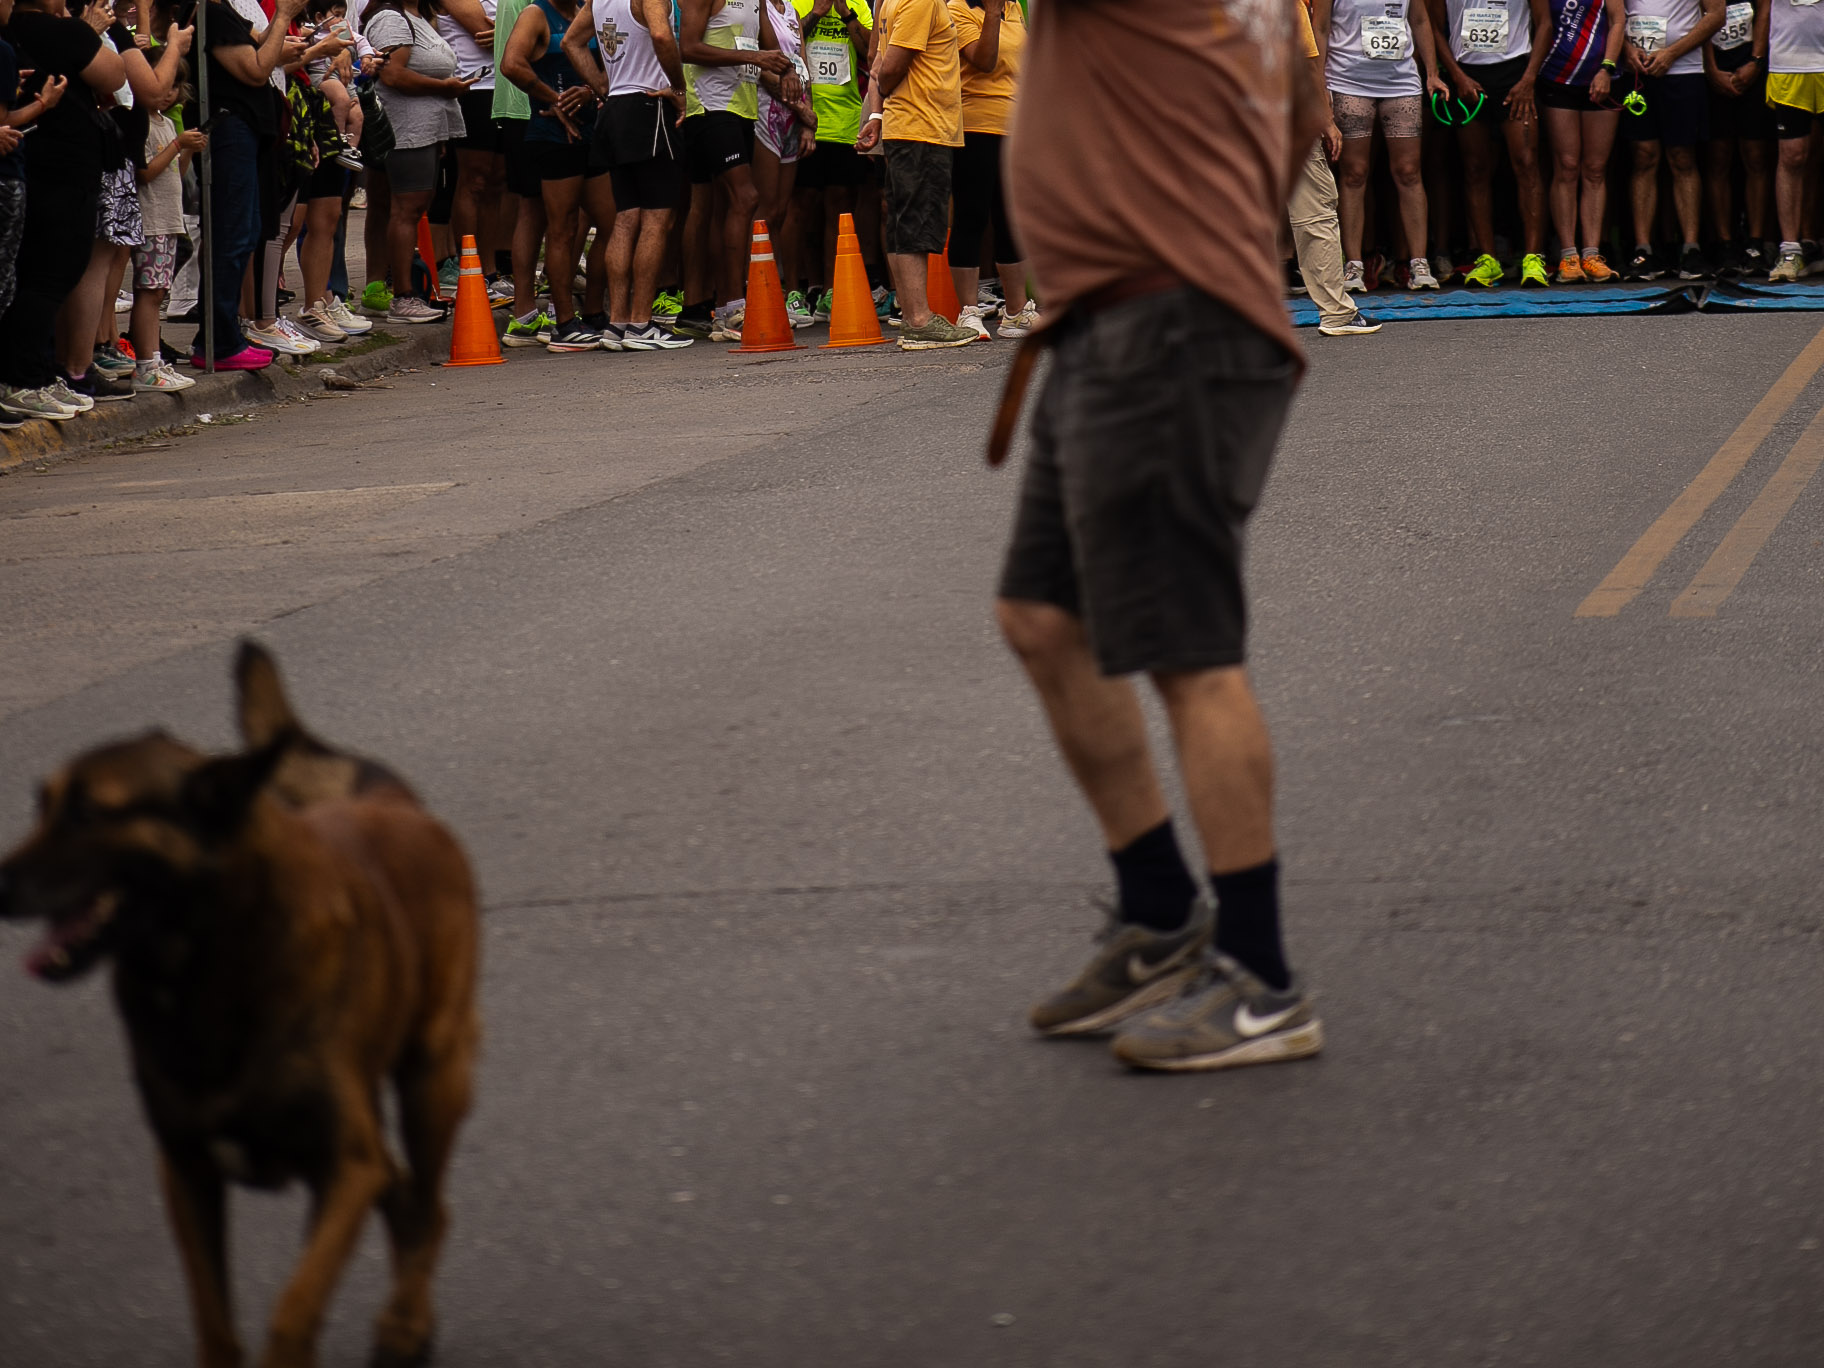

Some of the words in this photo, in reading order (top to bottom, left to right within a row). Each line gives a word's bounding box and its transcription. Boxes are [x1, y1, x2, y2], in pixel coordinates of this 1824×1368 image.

[1370, 35, 1400, 50] 652
[1470, 28, 1499, 43] 632
[819, 61, 838, 76] 50
